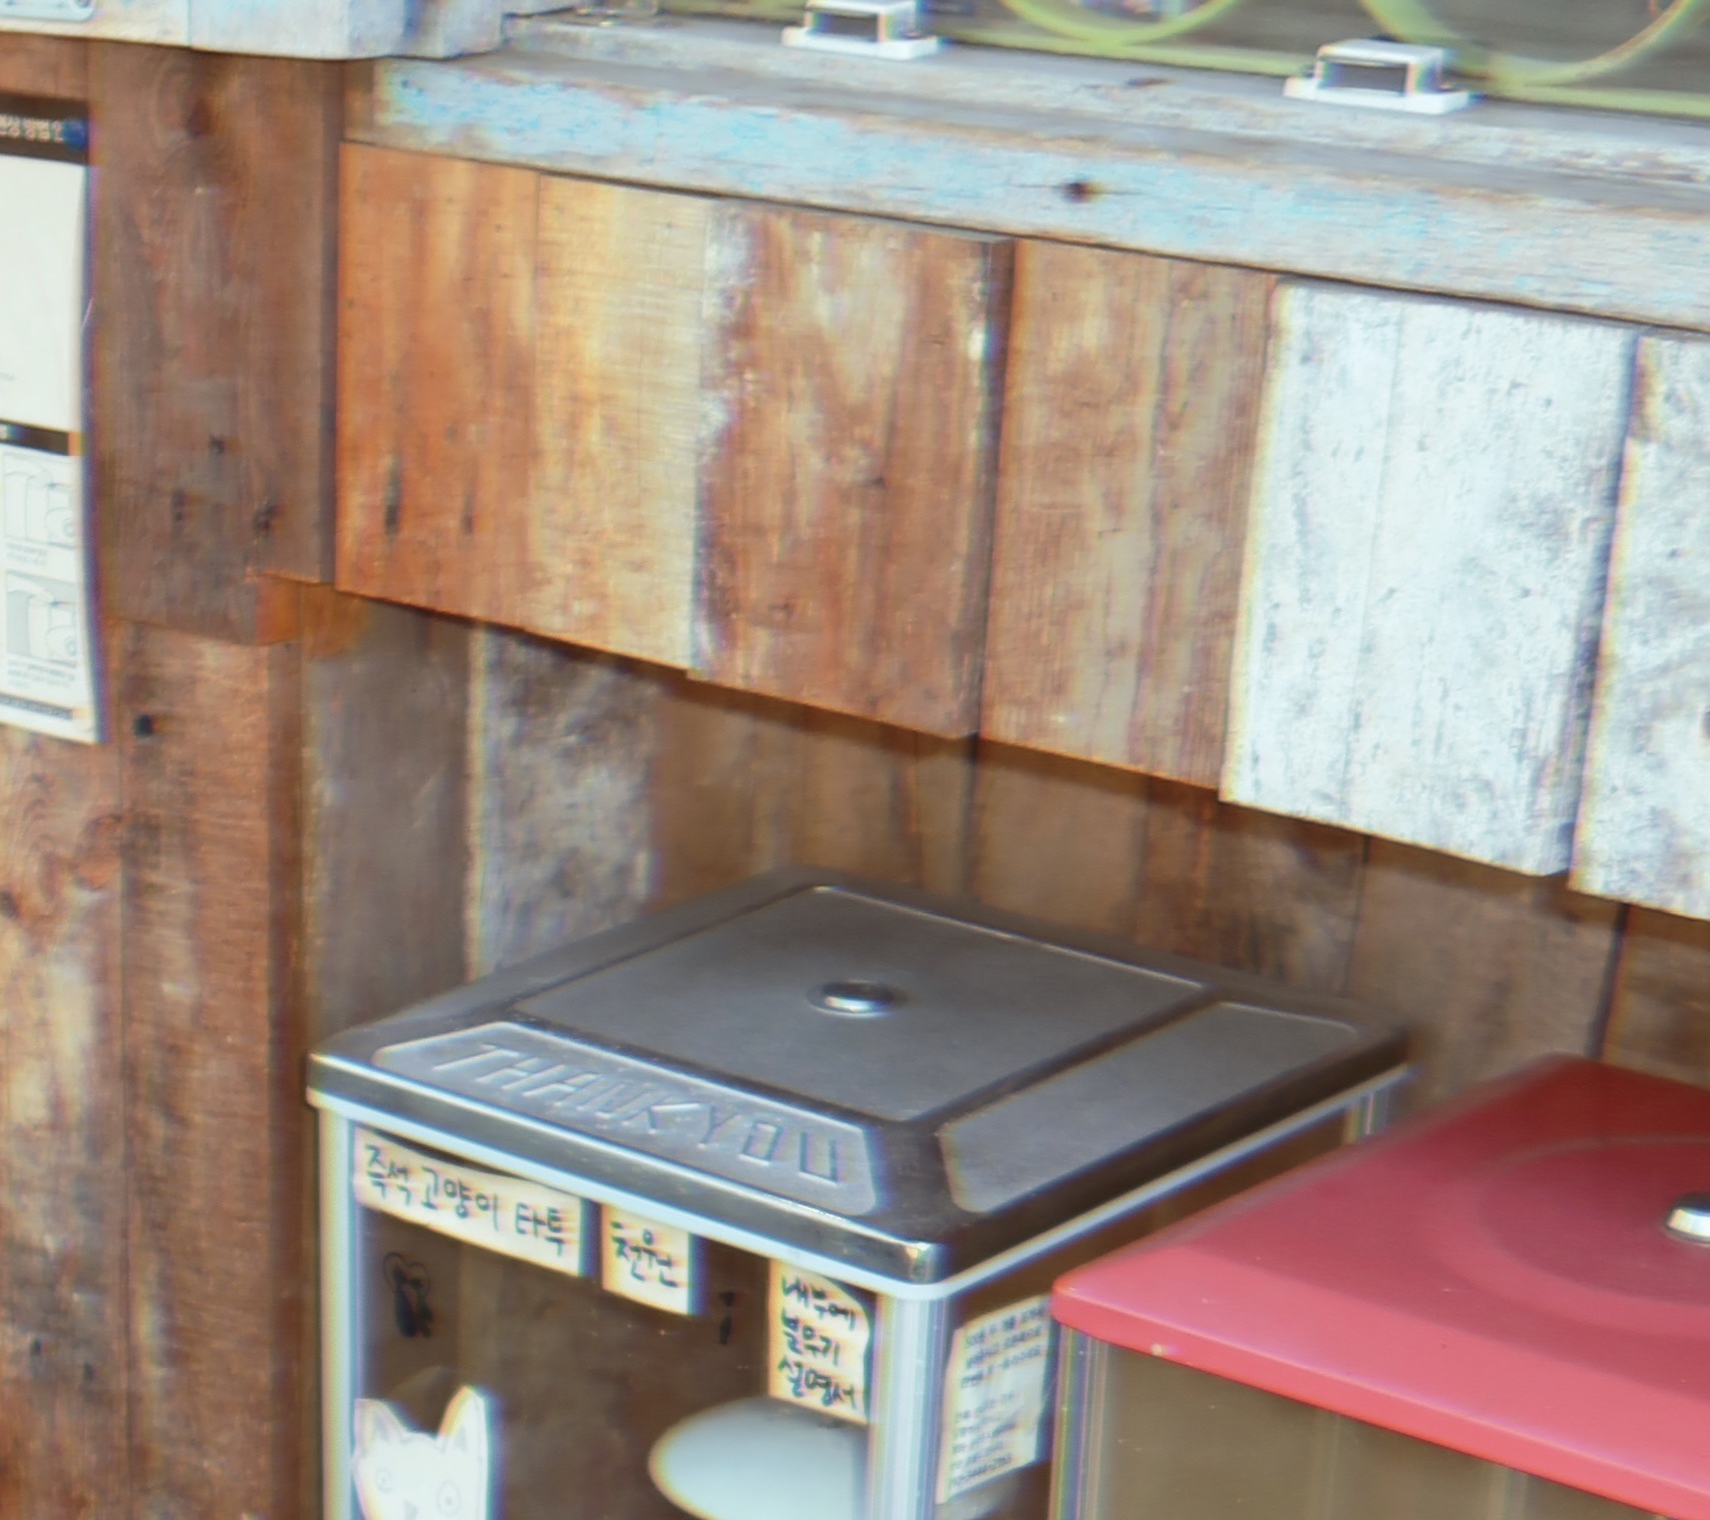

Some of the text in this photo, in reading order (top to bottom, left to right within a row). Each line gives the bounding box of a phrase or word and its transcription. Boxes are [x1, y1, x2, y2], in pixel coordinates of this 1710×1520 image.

[432, 1043, 842, 1188] THANK YOU
[364, 1143, 567, 1257] 즉석 고양이 타투
[611, 1219, 679, 1288] 천원
[781, 1274, 856, 1332] 내부에
[777, 1355, 856, 1410] 설명서
